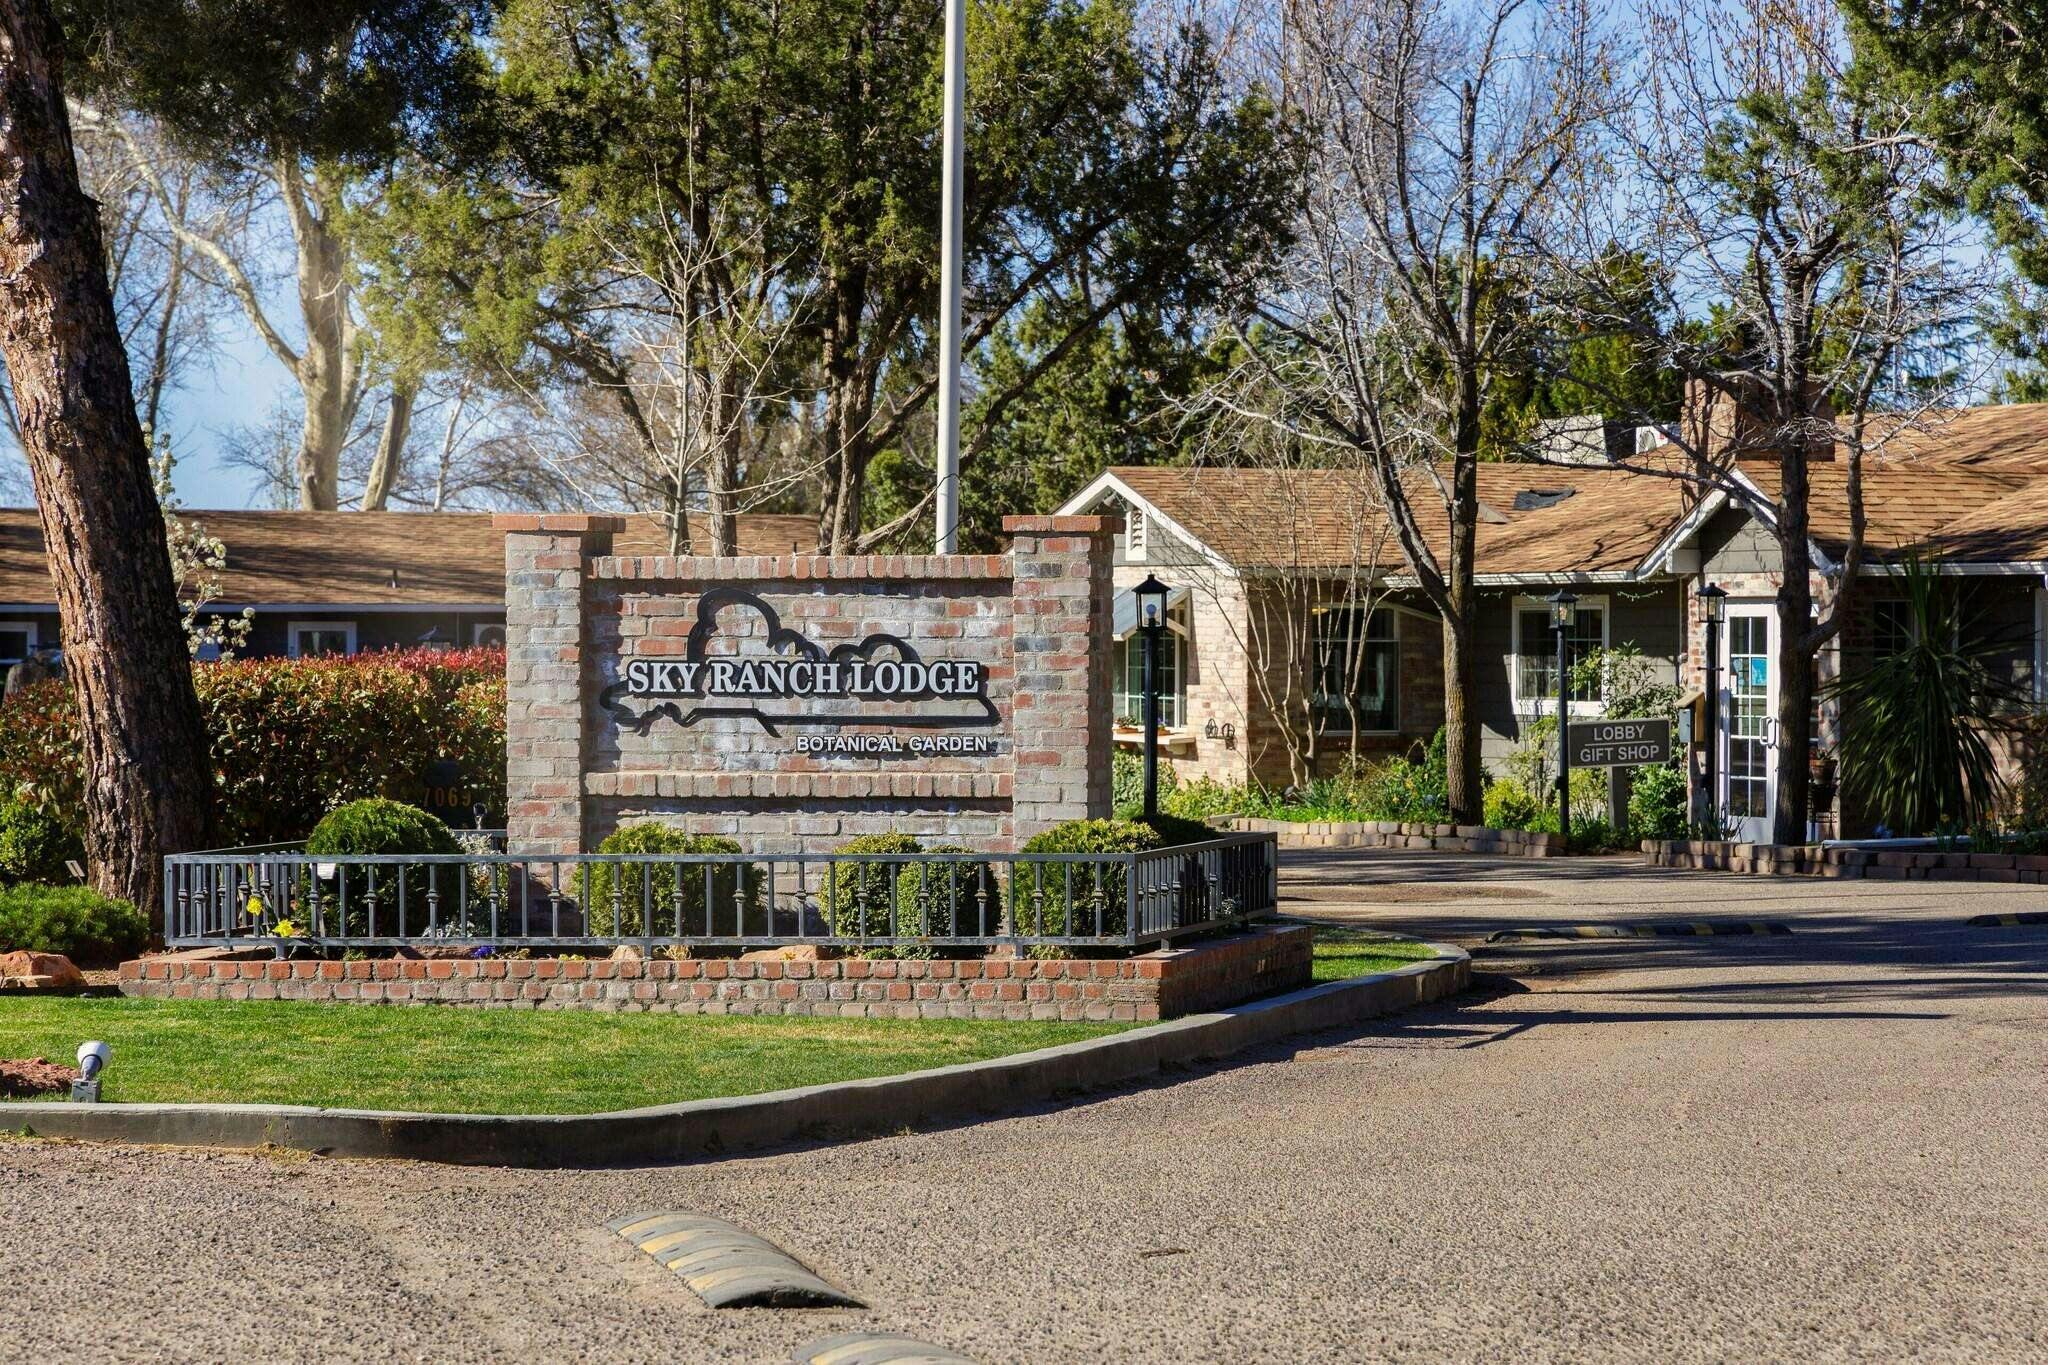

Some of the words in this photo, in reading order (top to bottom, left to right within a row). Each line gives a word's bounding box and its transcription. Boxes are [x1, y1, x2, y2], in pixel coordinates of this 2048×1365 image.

[628, 662, 700, 693] SKY
[710, 662, 840, 694] RANCH
[851, 662, 979, 694] LODGE
[1594, 725, 1645, 740] LOBBY
[796, 736, 903, 751] BOTANICAL
[909, 736, 988, 751] GARDEN
[1580, 747, 1614, 762] GIFT
[1618, 745, 1659, 760] SHOP
